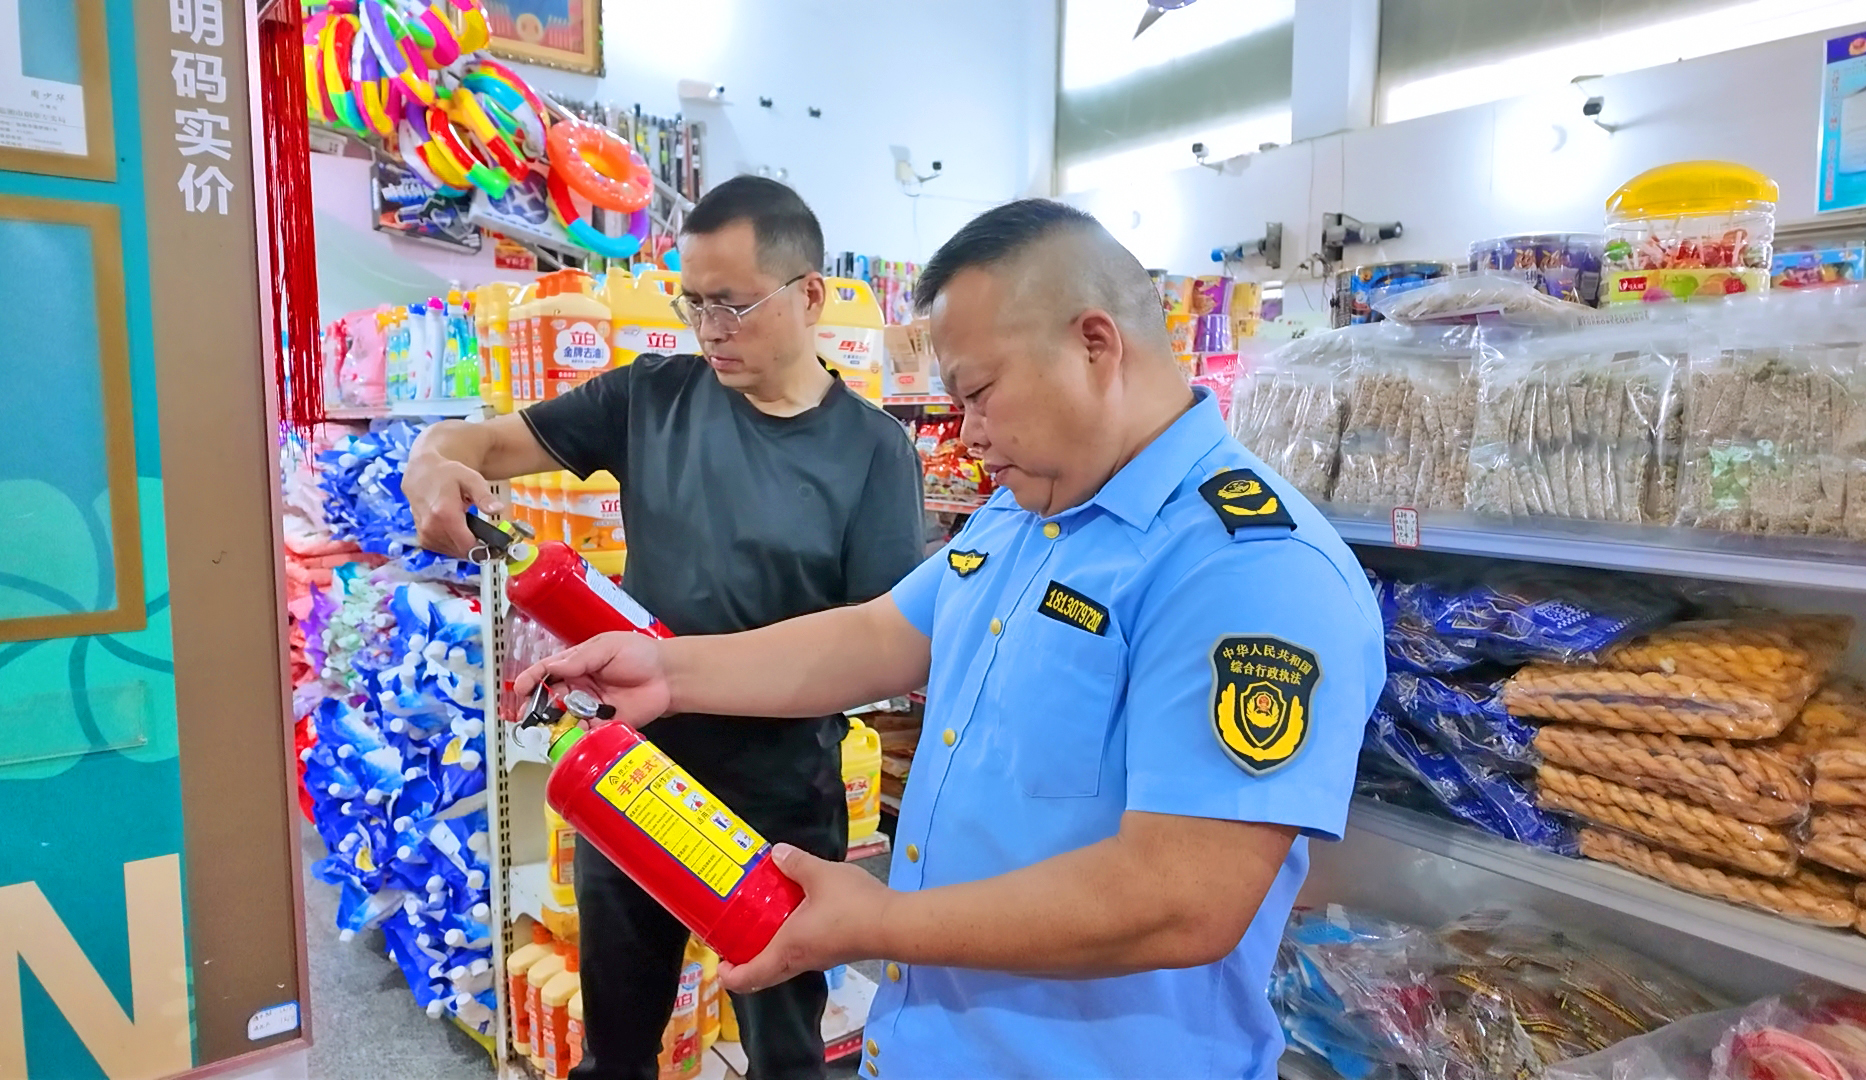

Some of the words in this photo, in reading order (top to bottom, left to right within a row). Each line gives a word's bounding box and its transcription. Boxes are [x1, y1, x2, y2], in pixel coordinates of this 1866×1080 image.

[169, 0, 235, 215] 明码实价
[570, 331, 596, 346] 立白
[646, 332, 677, 348] 立白
[563, 346, 602, 359] 金牌去油
[1222, 643, 1314, 676] 中华人民共和国
[1230, 659, 1302, 685] 综合行政执法
